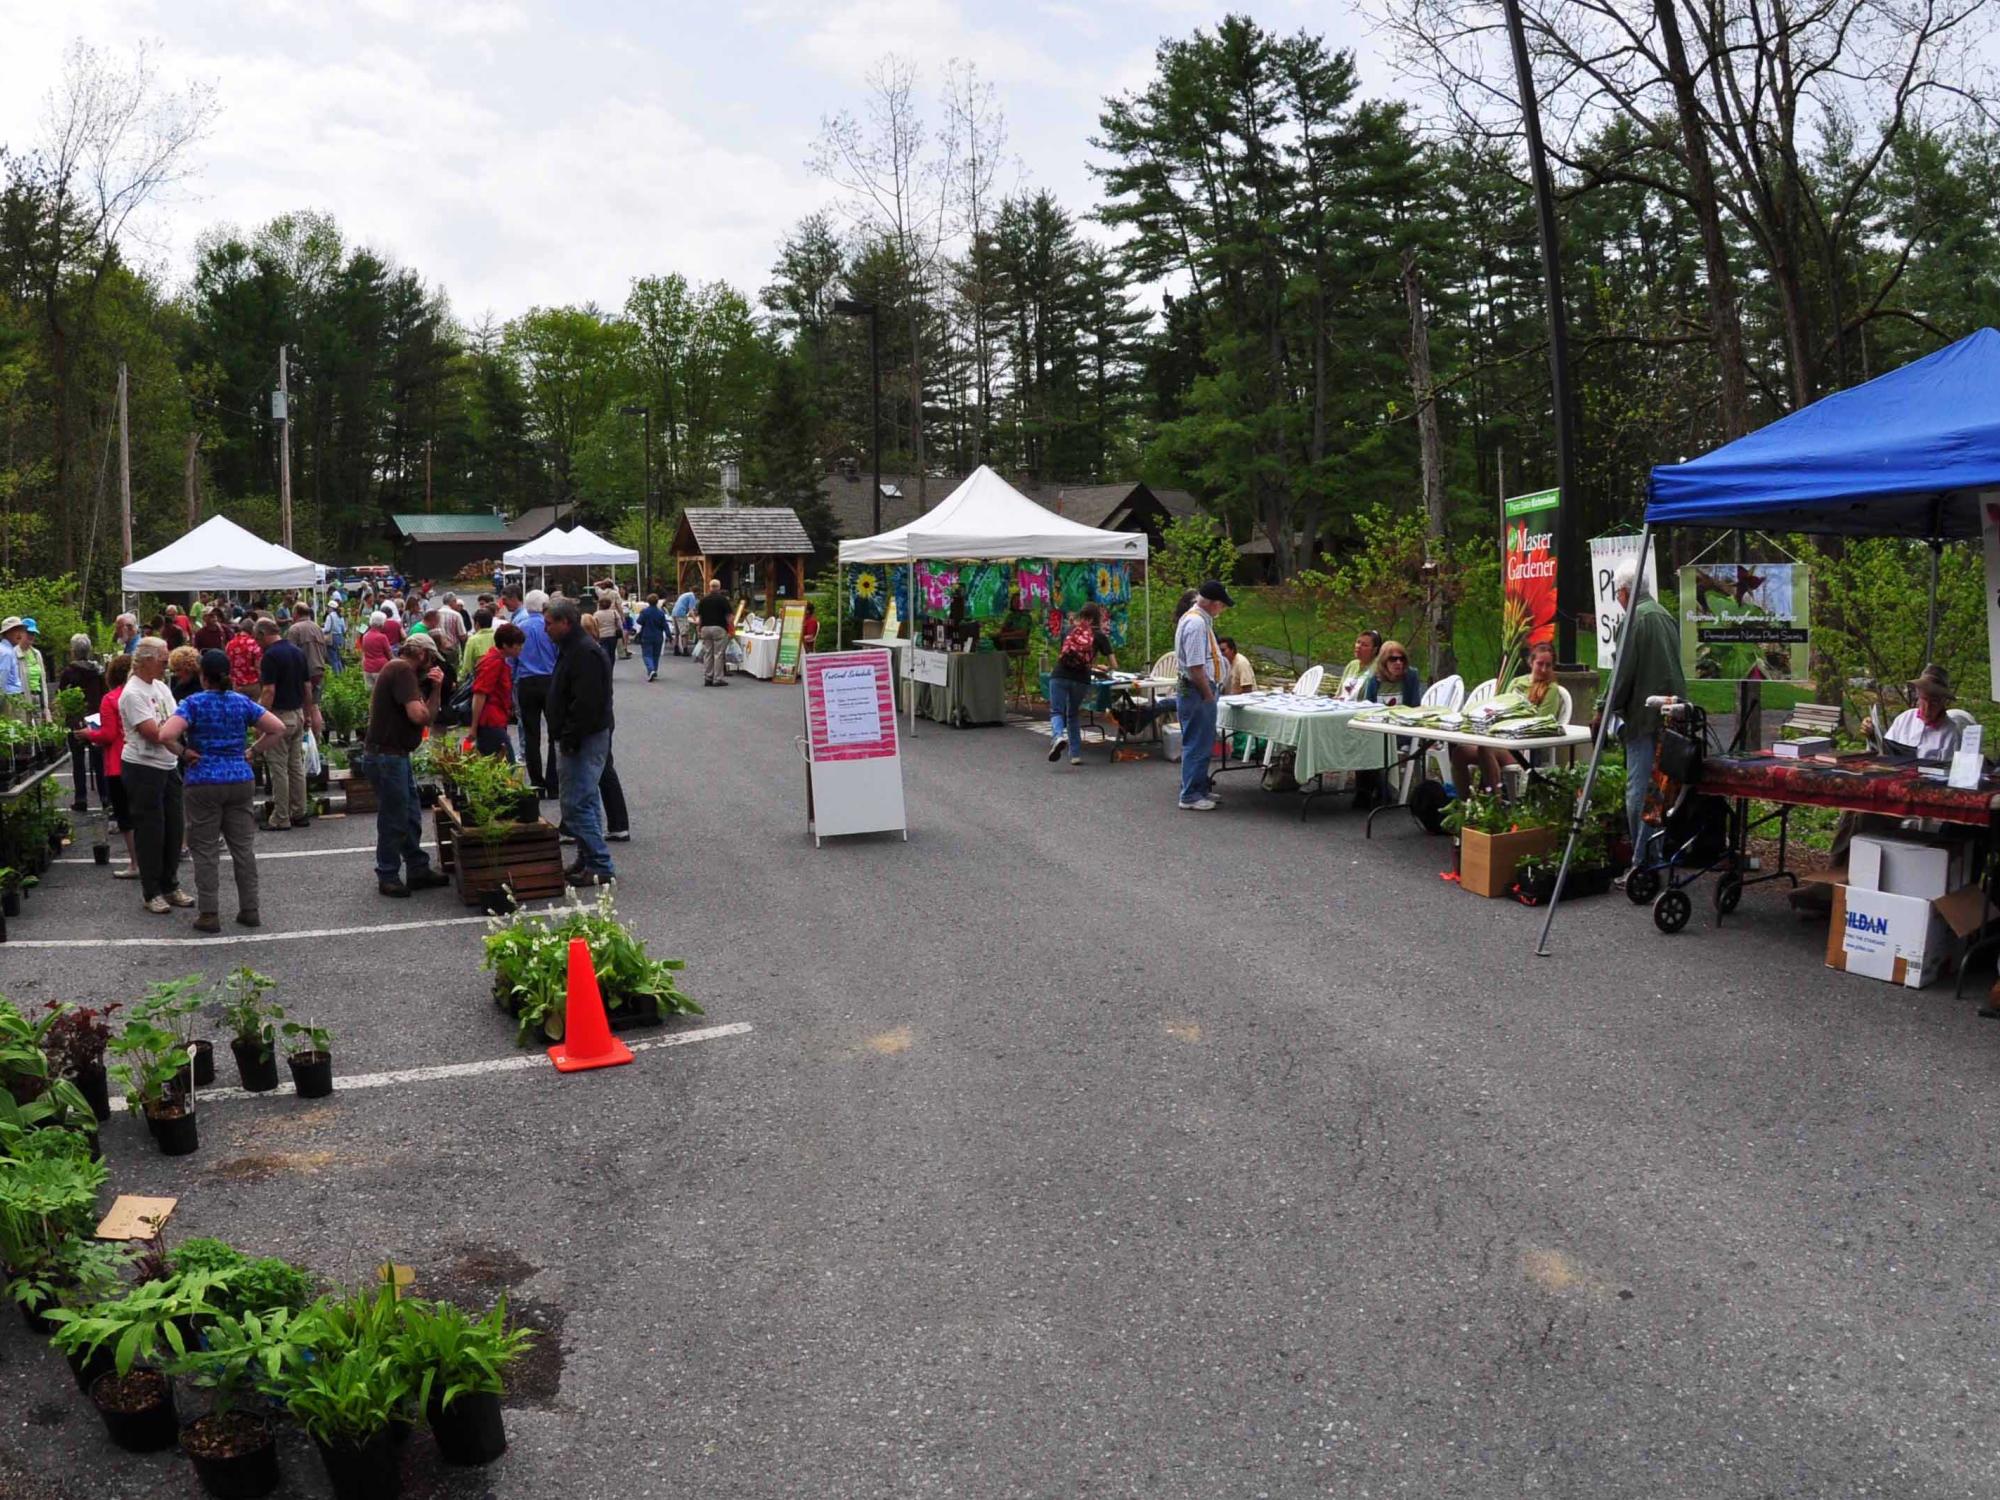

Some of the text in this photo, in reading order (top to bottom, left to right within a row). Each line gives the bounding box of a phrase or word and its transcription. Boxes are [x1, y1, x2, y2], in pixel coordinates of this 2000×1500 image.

[1517, 527, 1552, 552] Master
[1507, 554, 1555, 580] Gardener
[1741, 630, 1762, 640] Native
[1763, 630, 1780, 641] Plant
[825, 668, 872, 680] Festival Schedule
